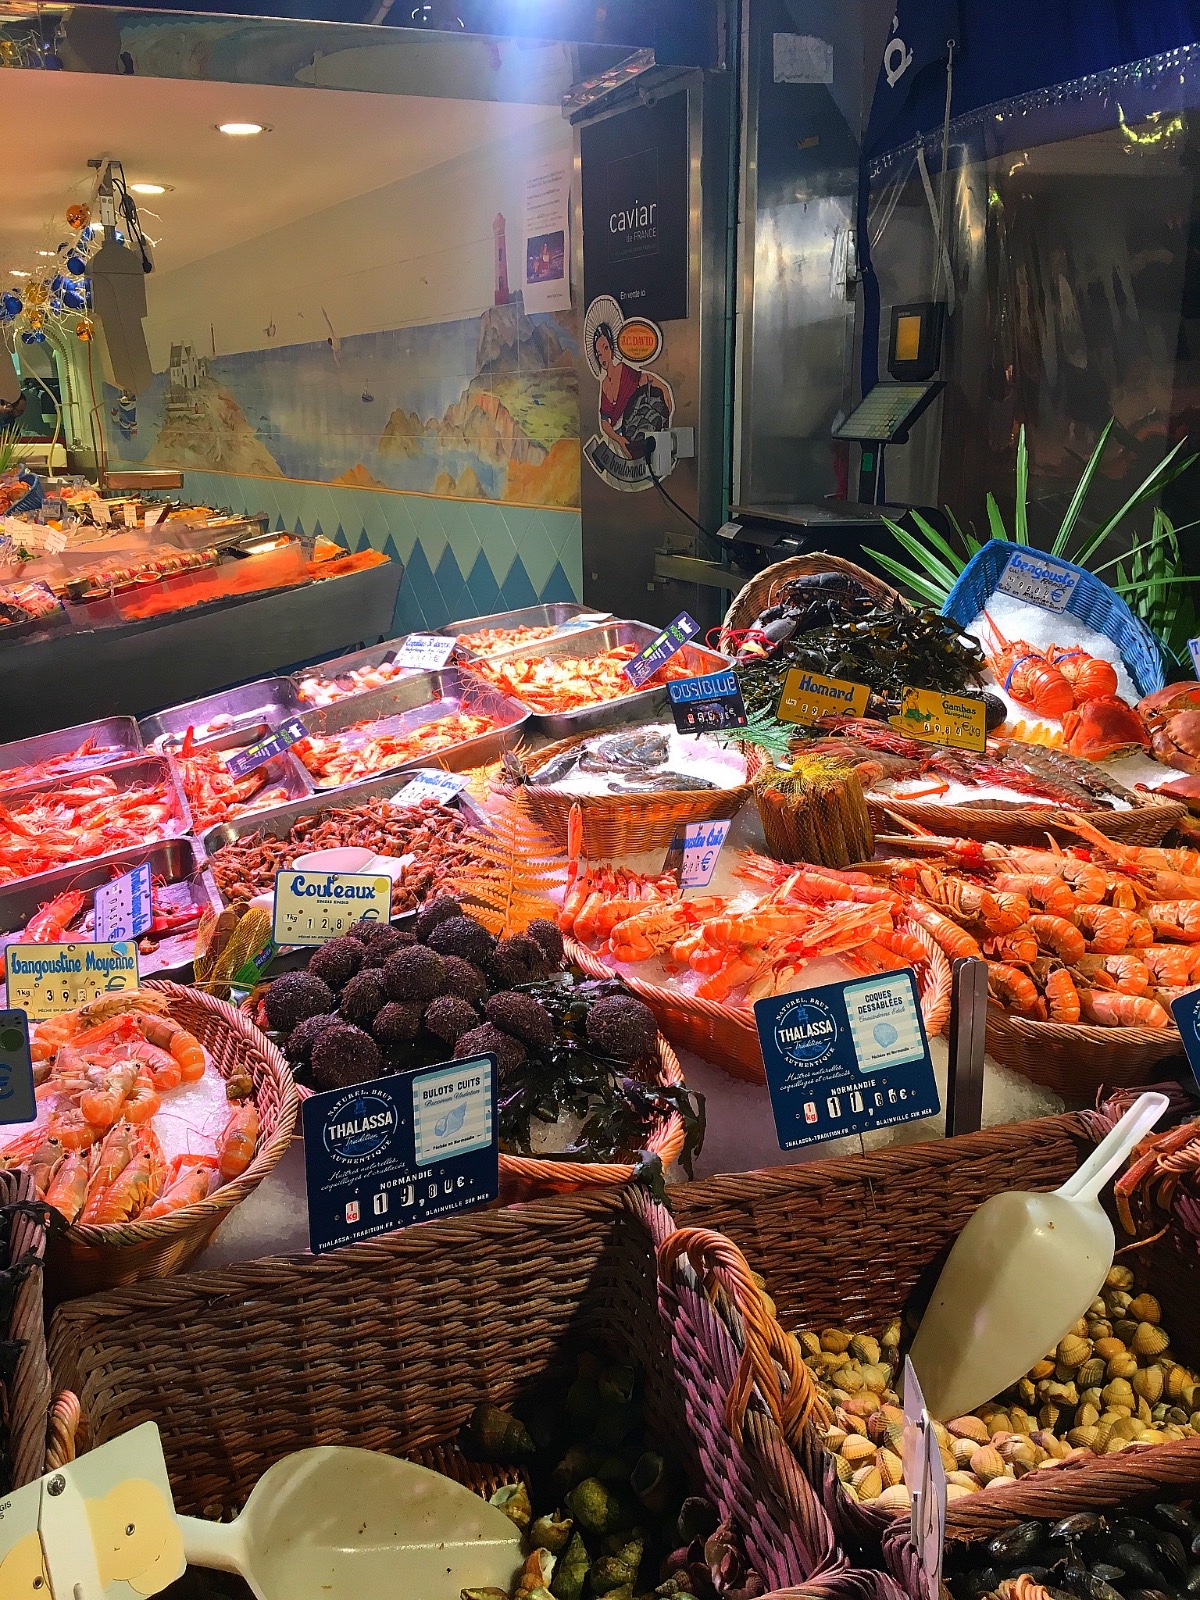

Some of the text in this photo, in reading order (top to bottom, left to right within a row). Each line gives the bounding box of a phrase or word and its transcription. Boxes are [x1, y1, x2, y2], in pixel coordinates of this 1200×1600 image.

[609, 200, 657, 233] caviar
[633, 227, 657, 241] FRANCE
[620, 291, 627, 300] En
[627, 290, 640, 299] vente
[1010, 554, 1075, 587] Langouste
[1051, 588, 1066, 603] €
[670, 677, 737, 699] OBSIBLUE
[800, 674, 854, 702] Homard
[942, 701, 976, 715] Gambas
[701, 850, 714, 871] €
[290, 875, 376, 899] Couteaux
[11, 950, 135, 981] Langoustine Moyenne
[17, 989, 31, 997] 1kg
[864, 989, 892, 1003] COQUES
[809, 997, 829, 1010] BRUT
[857, 996, 903, 1014] DESSABLÉES
[778, 1020, 833, 1043] THALASSA
[793, 1035, 822, 1049] Tradition
[784, 1046, 834, 1067] AUTHENTIQUE
[422, 1076, 480, 1099] BULOTS CUITS
[778, 1076, 814, 1093] coquillages
[830, 1079, 876, 1096] NORMANDIE
[371, 1088, 392, 1101] BRUT
[806, 1103, 811, 1112] 1
[328, 1110, 392, 1140] THALASSA
[805, 1113, 816, 1122] kg
[876, 1113, 908, 1126] BLAINVILLE
[344, 1129, 378, 1146] Tradition
[330, 1140, 391, 1164] AUTHENTIQUE
[320, 1172, 361, 1193] coquillages
[363, 1170, 371, 1178] et
[327, 1165, 358, 1181] Huîtres
[380, 1169, 432, 1189] NORMANDIE
[349, 1202, 354, 1212] 1
[425, 1201, 461, 1216] BLAINVILLE
[477, 1193, 488, 1201] MER
[346, 1211, 357, 1222] kg
[318, 1222, 393, 1249] THALASSA-TRADITION.FR
